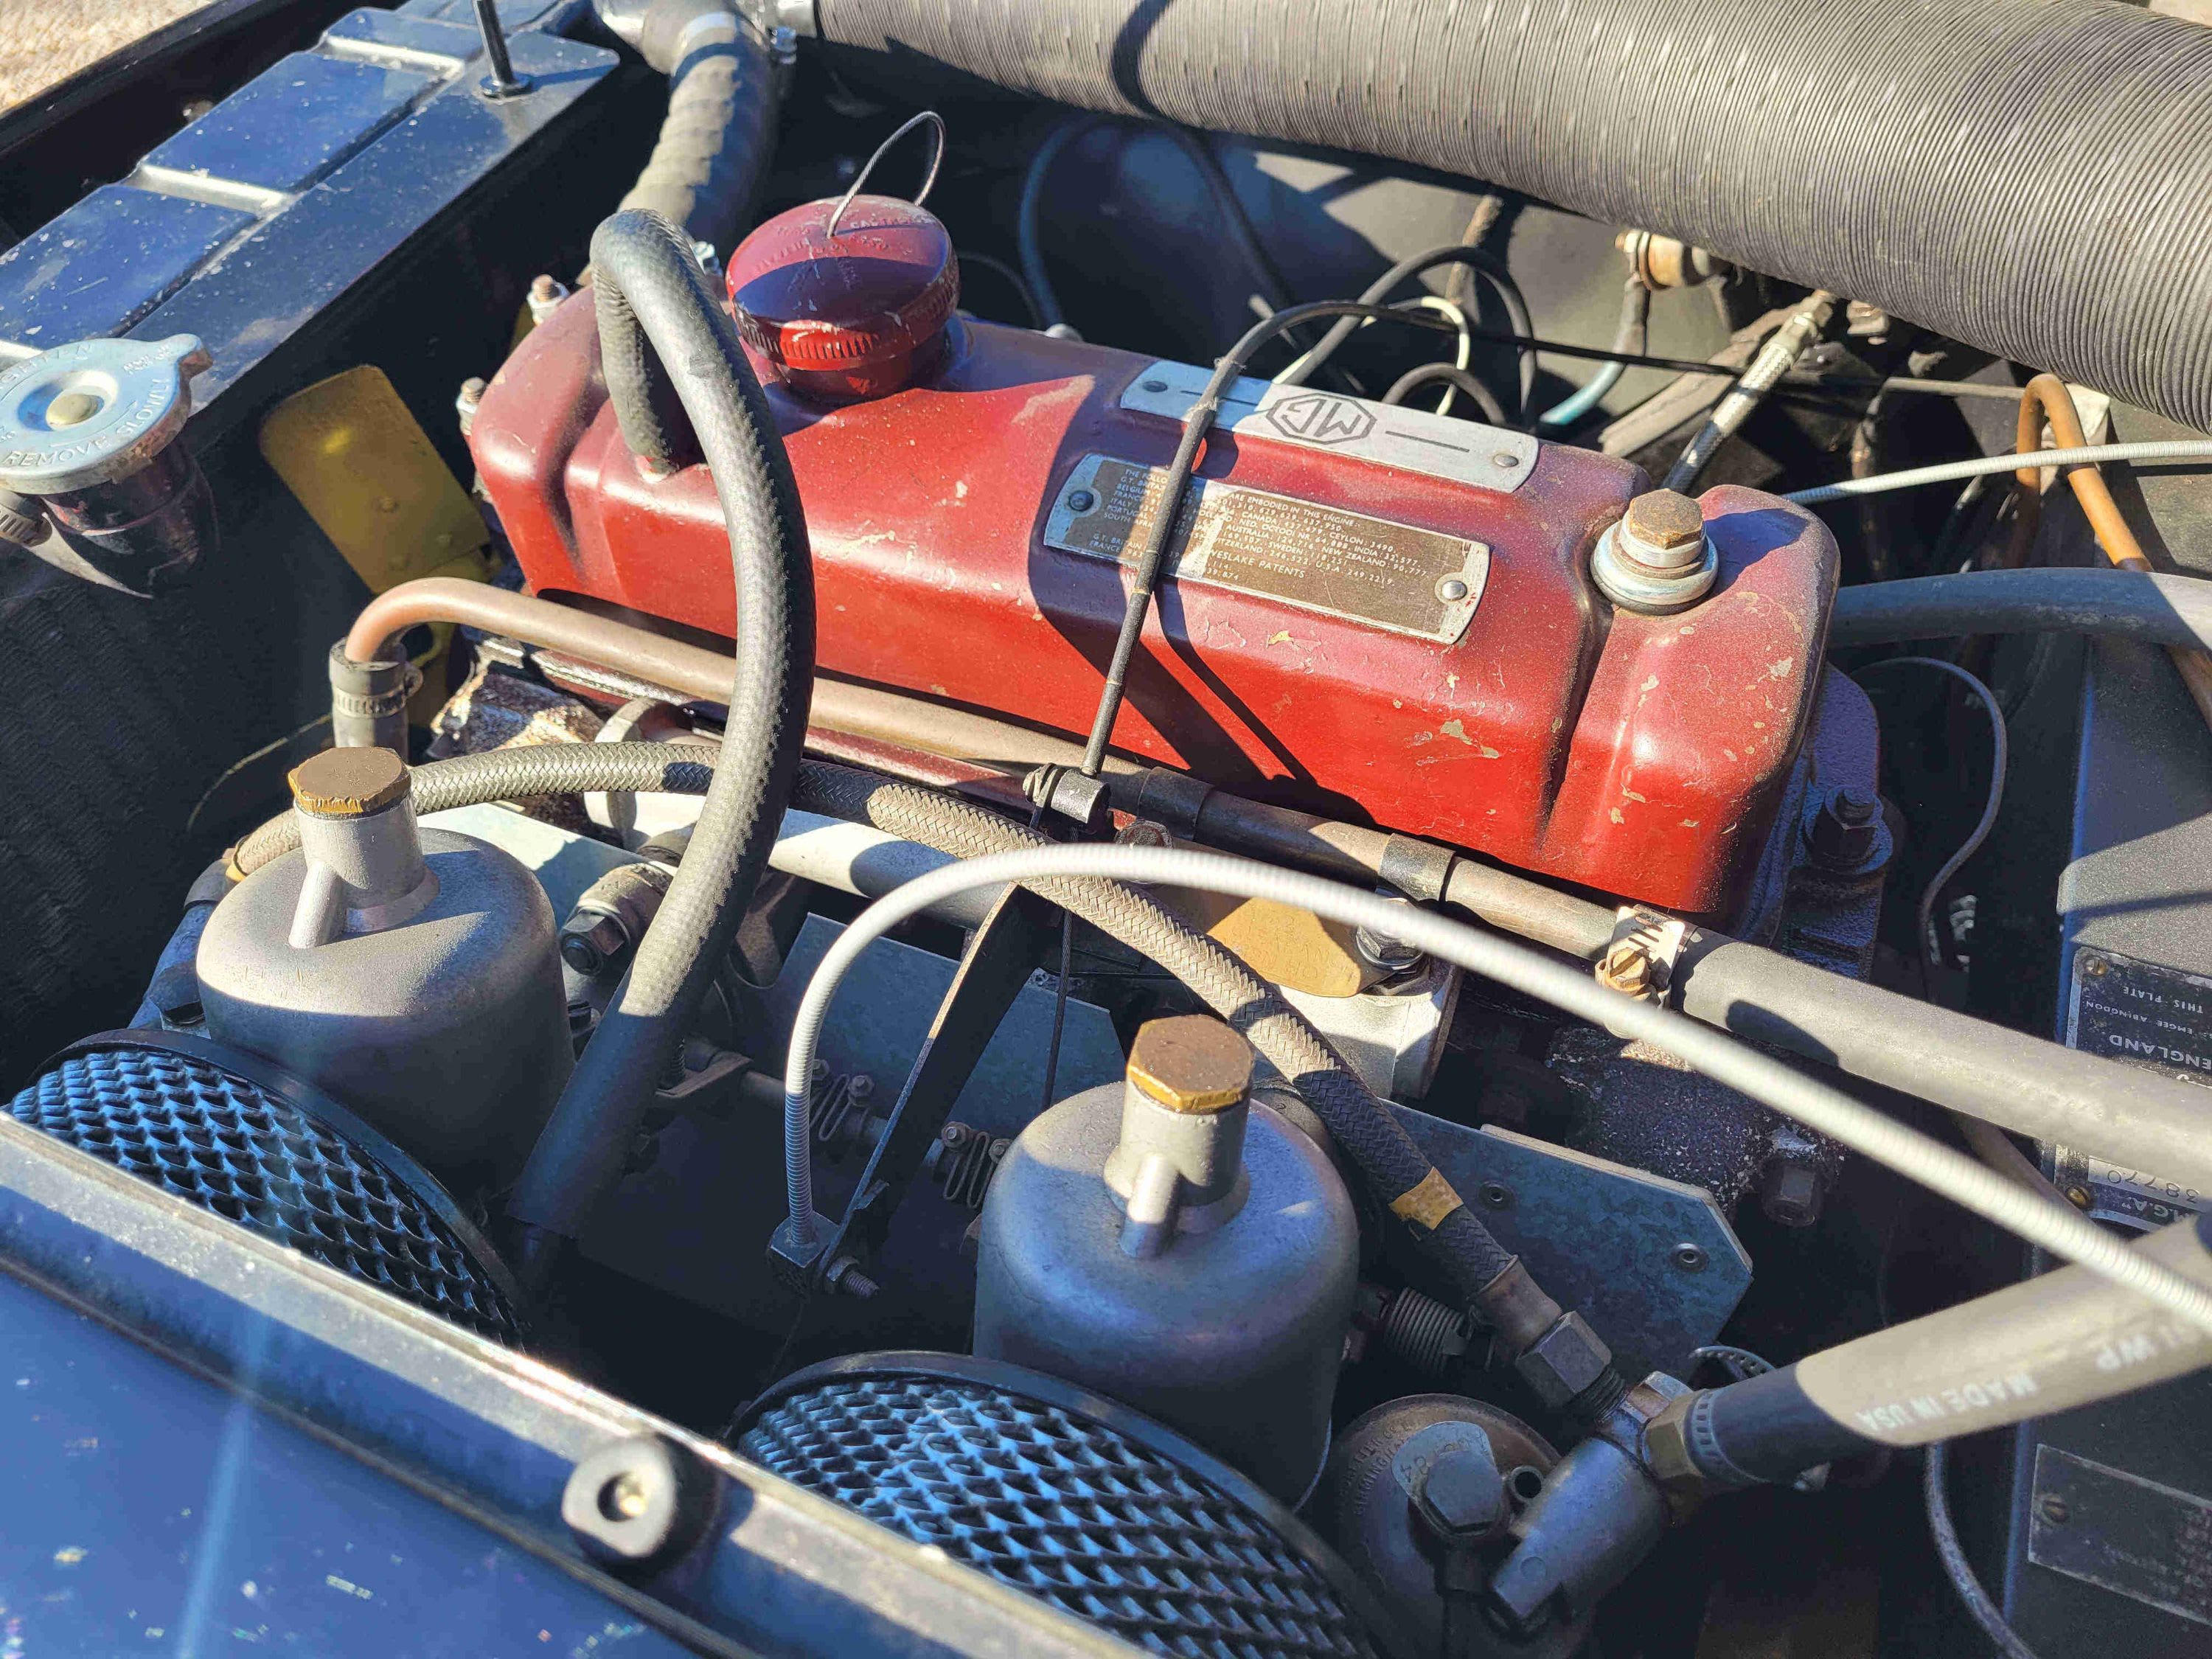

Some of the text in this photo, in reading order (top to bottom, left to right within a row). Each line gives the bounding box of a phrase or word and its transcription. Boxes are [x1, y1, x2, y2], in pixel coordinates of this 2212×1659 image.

[2, 378, 170, 466] REMOVE SLOWLY
[1276, 398, 1368, 440] MG
[1125, 469, 1140, 479] THE
[1229, 493, 1245, 501] ARE
[1248, 495, 1288, 511] EMBODIED
[1290, 505, 1300, 513] IN
[1303, 509, 1321, 519] THIS
[1104, 512, 1131, 524] SOUTH
[1321, 546, 1343, 556] NEW
[1258, 560, 1306, 579] PATENTS
[2122, 986, 2204, 1015] THIS PLATE
[2155, 1020, 2193, 1035] EMGEE
[2108, 1034, 2212, 1070] ENGLAND
[1854, 1371, 2039, 1433] MADE IN USA
